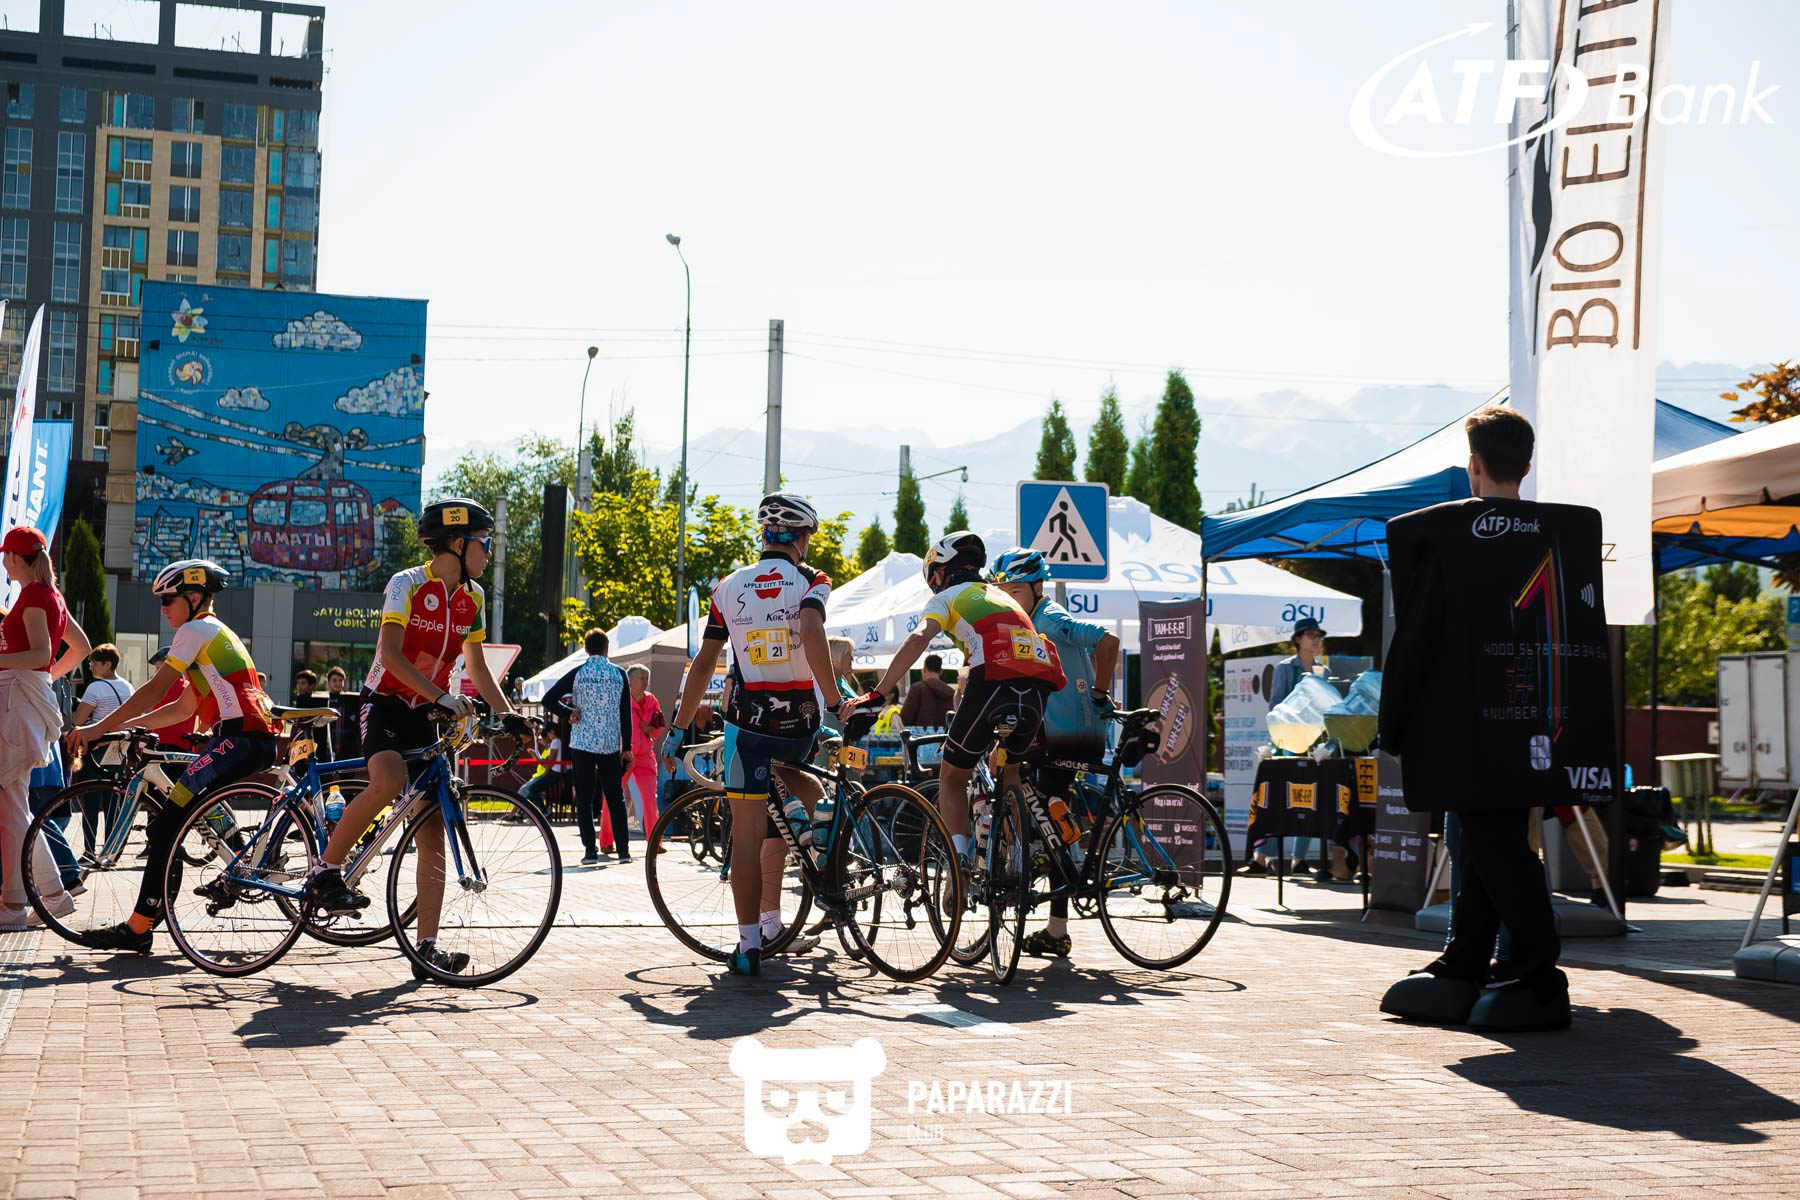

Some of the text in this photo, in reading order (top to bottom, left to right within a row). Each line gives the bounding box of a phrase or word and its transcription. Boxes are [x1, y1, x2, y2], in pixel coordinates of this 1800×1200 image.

[1546, 220, 1625, 352] BIO
[1476, 515, 1541, 534] ATF Bank
[334, 618, 367, 629] ОФИС
[410, 614, 444, 632] apple
[772, 646, 783, 657] 21
[1018, 644, 1031, 654] 27
[186, 754, 214, 776] KE
[848, 751, 857, 761] 21
[1563, 765, 1613, 790] VISA
